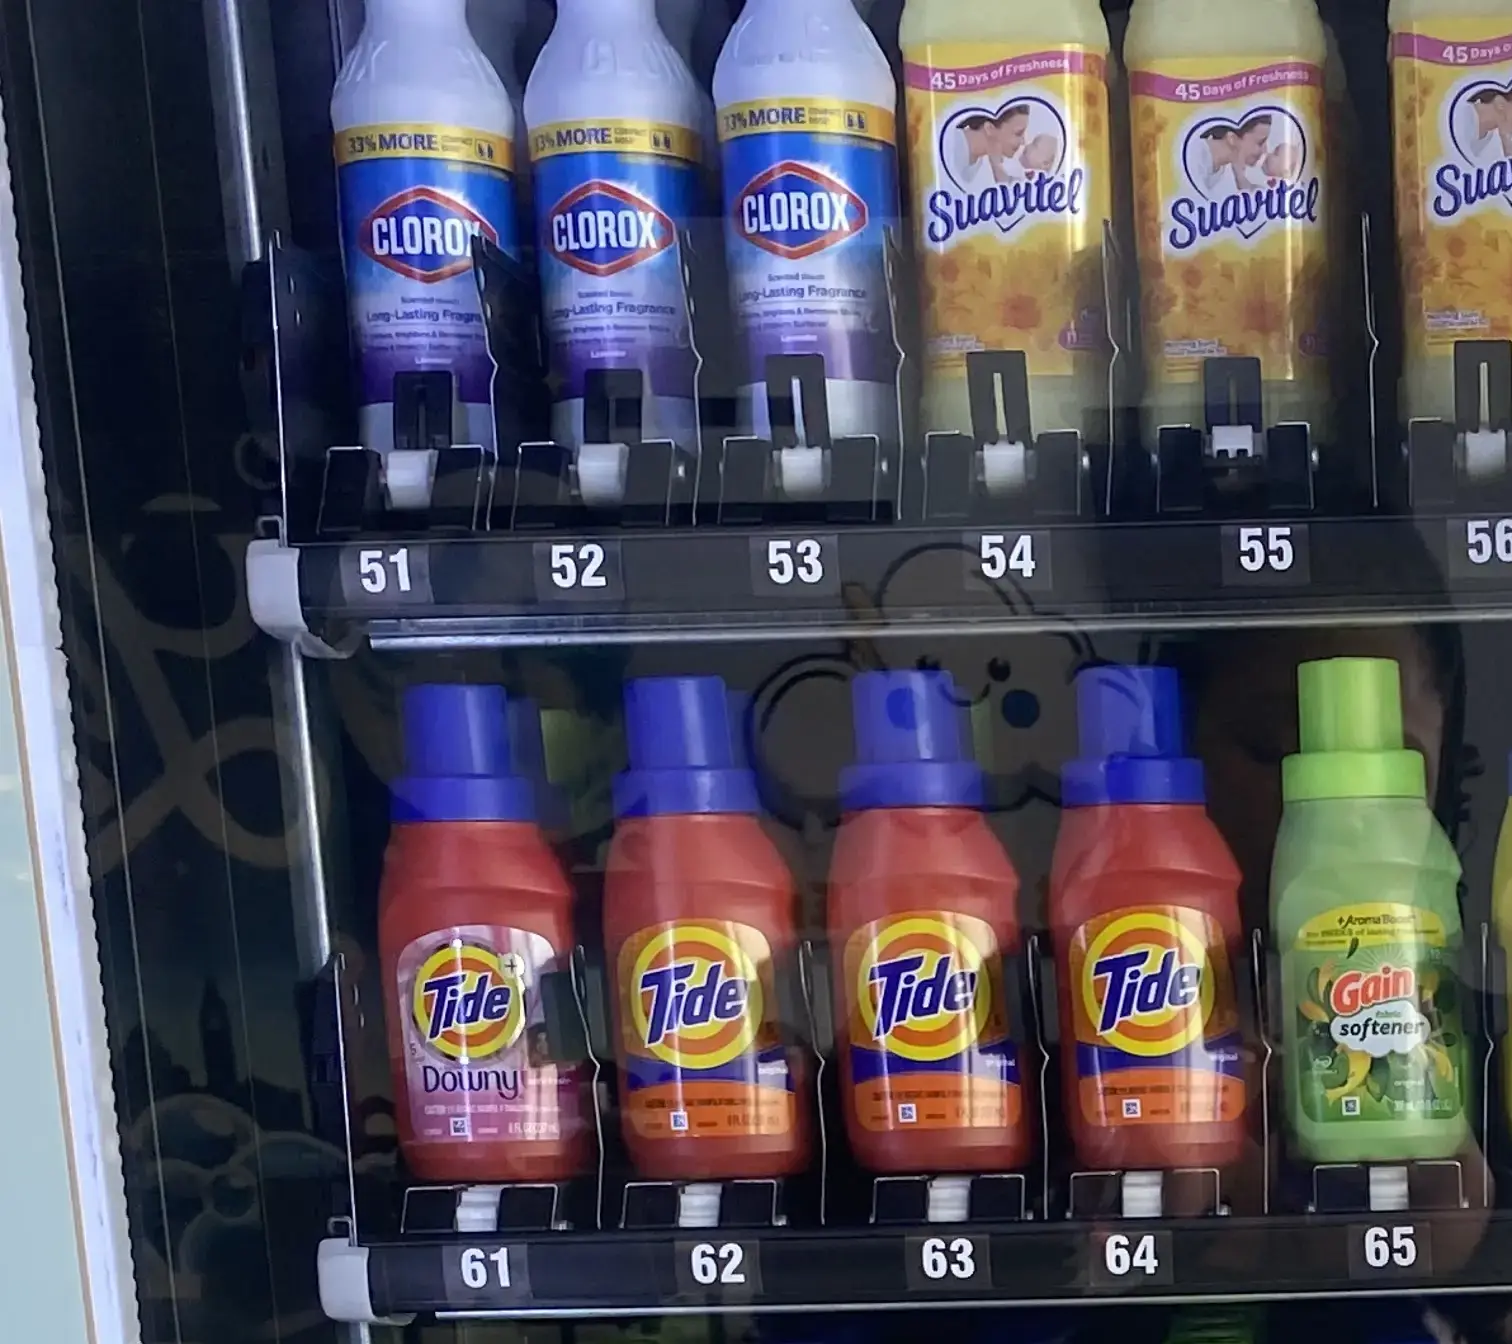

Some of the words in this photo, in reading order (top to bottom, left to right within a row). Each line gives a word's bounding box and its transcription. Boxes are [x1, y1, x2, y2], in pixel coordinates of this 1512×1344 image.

[930, 72, 957, 90] 45
[958, 71, 989, 87] Days
[991, 65, 1005, 80] of
[1006, 57, 1071, 76] Freshness
[1442, 46, 1468, 64] 45
[1470, 45, 1500, 61] Days
[1175, 83, 1201, 100] 45
[1202, 82, 1233, 97] Days
[1233, 76, 1247, 91] of
[556, 128, 613, 146] MORE
[748, 107, 806, 126] MORE
[378, 133, 439, 152] MORE
[742, 192, 850, 234] CLOROX
[927, 168, 1084, 243] Suavitel
[1168, 177, 1320, 250] Suavitel
[552, 210, 658, 252] CLOROX
[359, 548, 411, 592] 51
[550, 543, 607, 588] 52
[767, 539, 823, 584] 53
[980, 533, 1036, 579] 54
[1238, 526, 1294, 571] 55
[422, 971, 512, 1043] Tide
[640, 959, 748, 1049] Tide
[869, 952, 979, 1043] Tide
[1092, 947, 1203, 1036] Tide
[1330, 964, 1417, 1017] Gain
[1339, 1018, 1425, 1042] softener
[422, 1064, 520, 1100] Downy
[460, 1246, 511, 1289] 61
[691, 1242, 746, 1285] 62
[922, 1237, 975, 1280] 63
[1104, 1233, 1158, 1276] 64
[1364, 1225, 1417, 1267] 65
